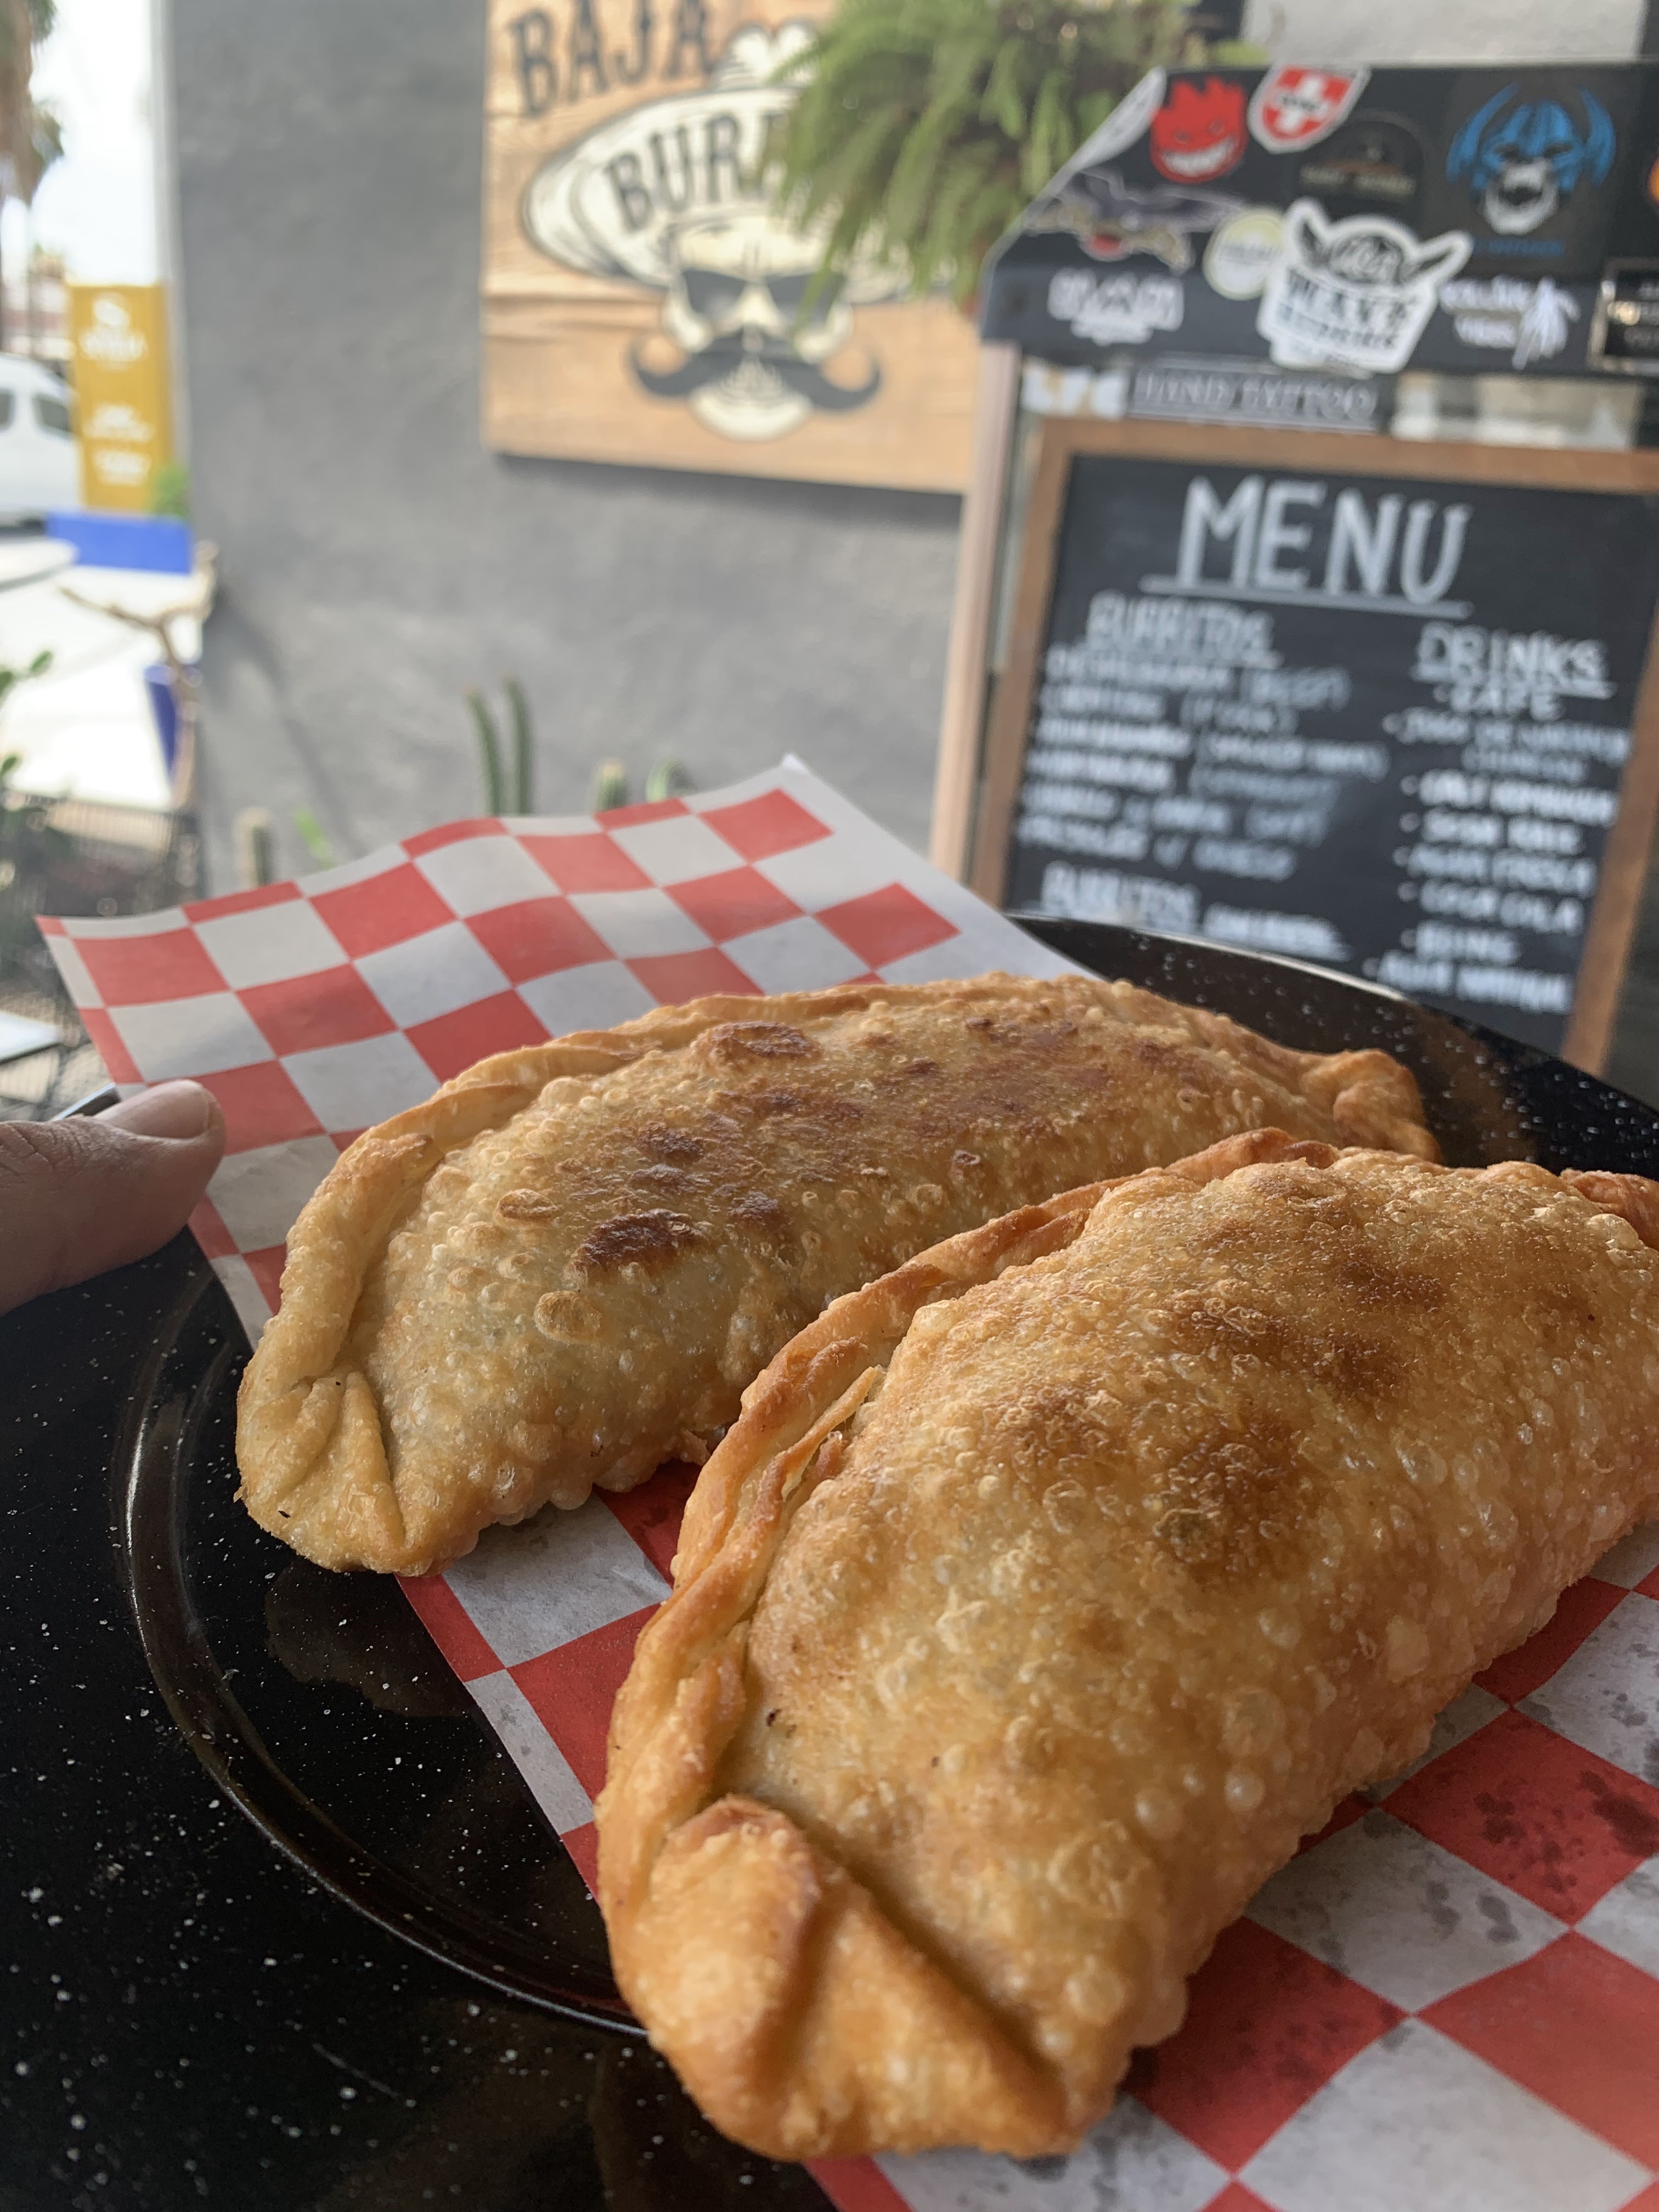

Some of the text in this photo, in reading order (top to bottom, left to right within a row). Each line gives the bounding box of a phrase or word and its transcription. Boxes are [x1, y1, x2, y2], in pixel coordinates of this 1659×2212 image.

[508, 0, 716, 117] BAJA
[1174, 474, 1474, 603] MENU
[1418, 623, 1609, 685] DRINKS
